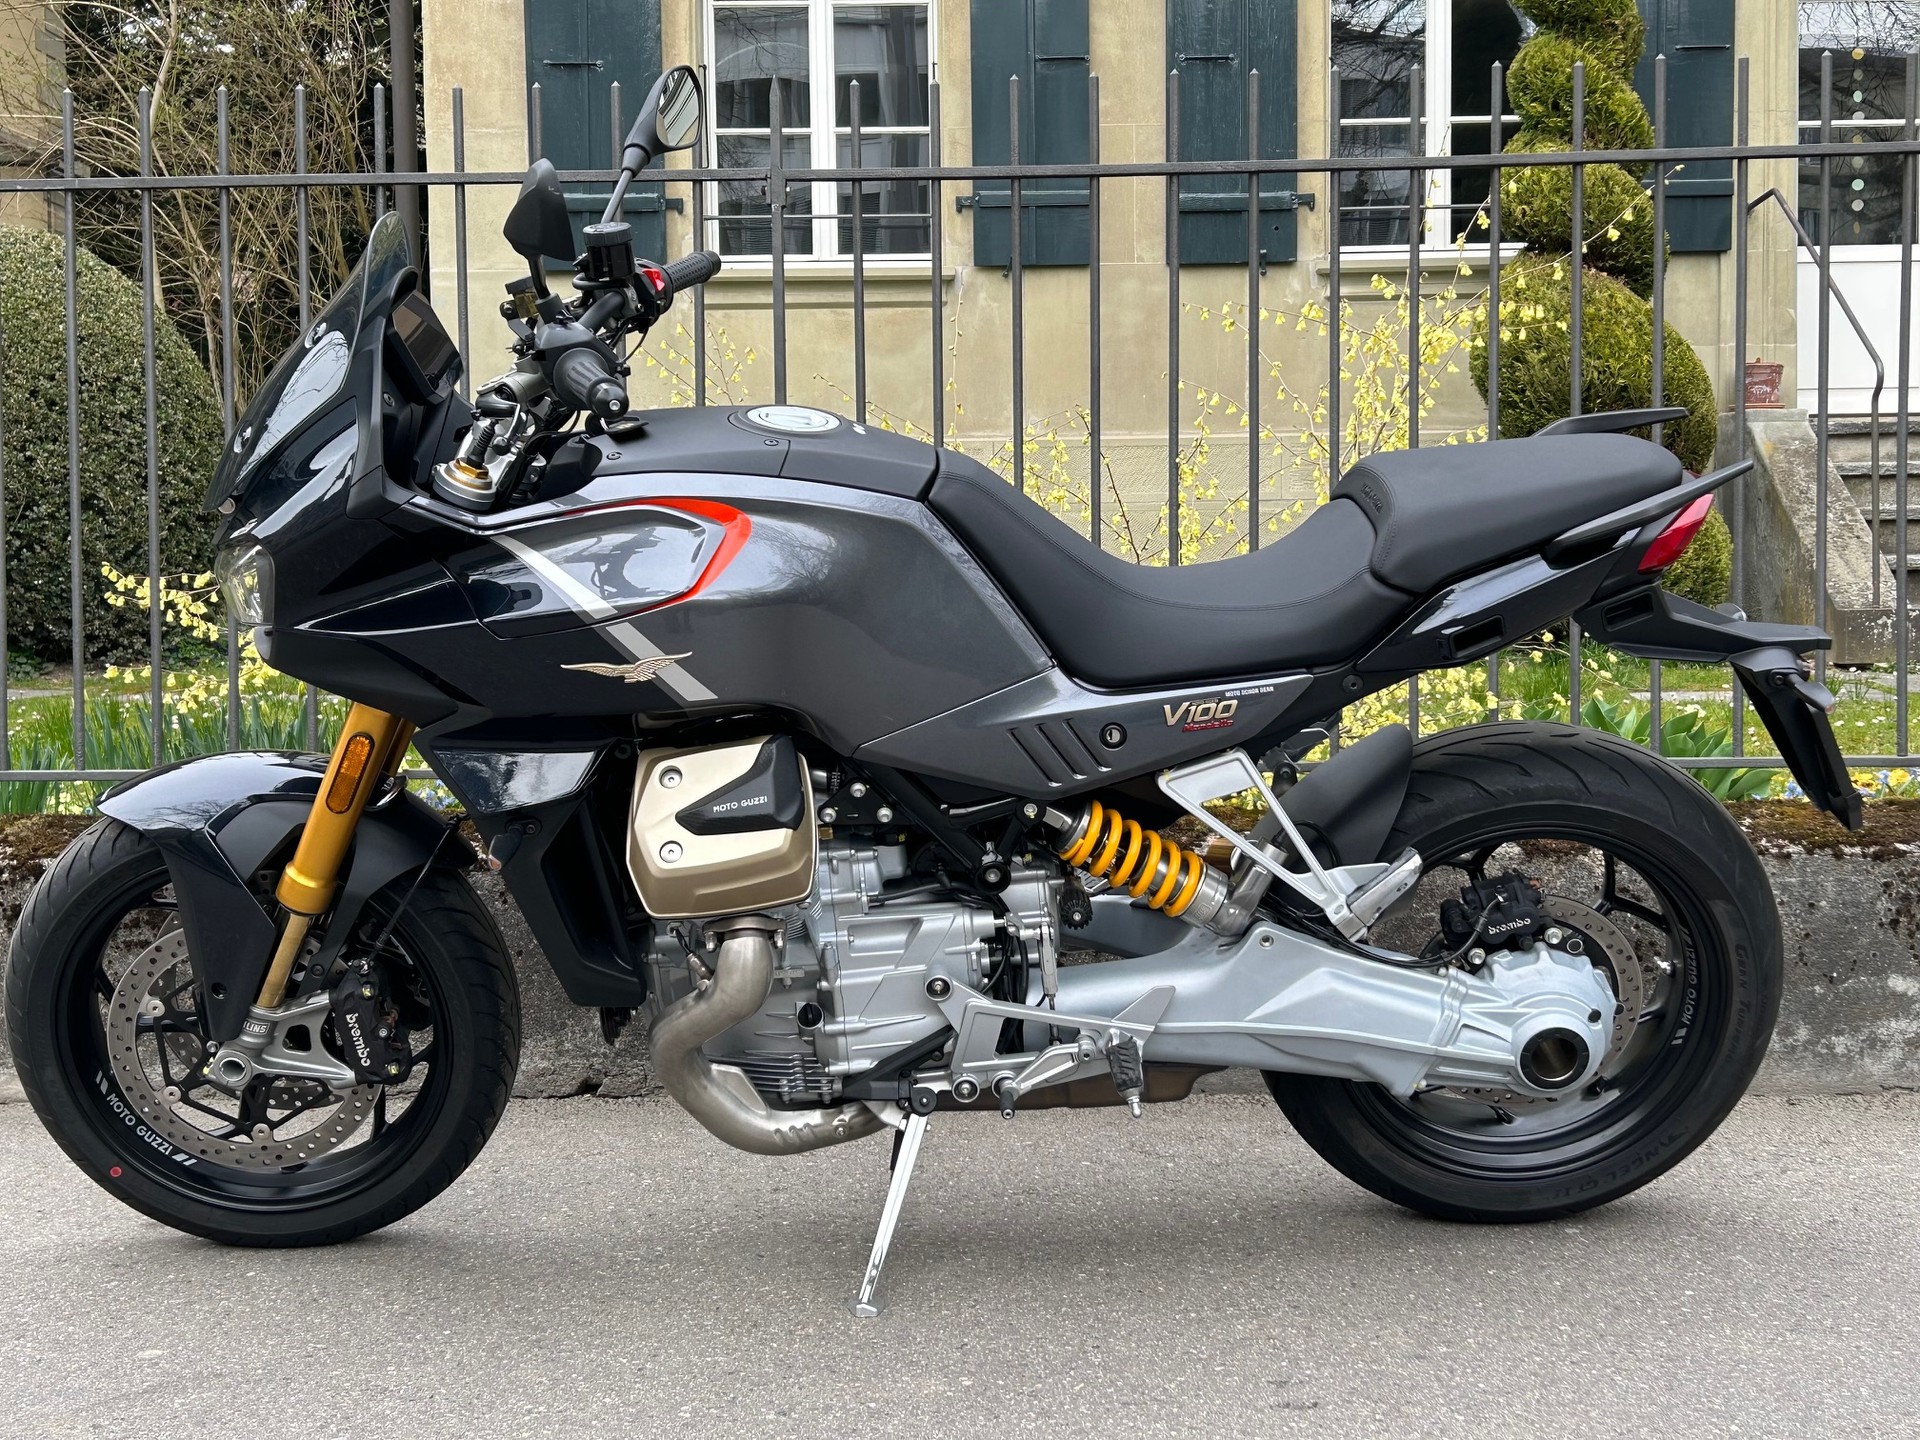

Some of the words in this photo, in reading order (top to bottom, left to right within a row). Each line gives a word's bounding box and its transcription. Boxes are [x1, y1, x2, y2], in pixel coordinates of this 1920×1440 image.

[1163, 699, 1238, 726] V100
[713, 801, 738, 813] MOTO
[740, 795, 768, 807] GUZZI
[1487, 918, 1532, 935] brembo
[1686, 947, 1698, 985] GUZZI
[1681, 989, 1697, 1025] MOTO
[243, 1020, 267, 1033] LINS
[345, 1012, 371, 1067] brembo
[106, 1093, 136, 1126] MOTO
[136, 1125, 173, 1155] GUZZI
